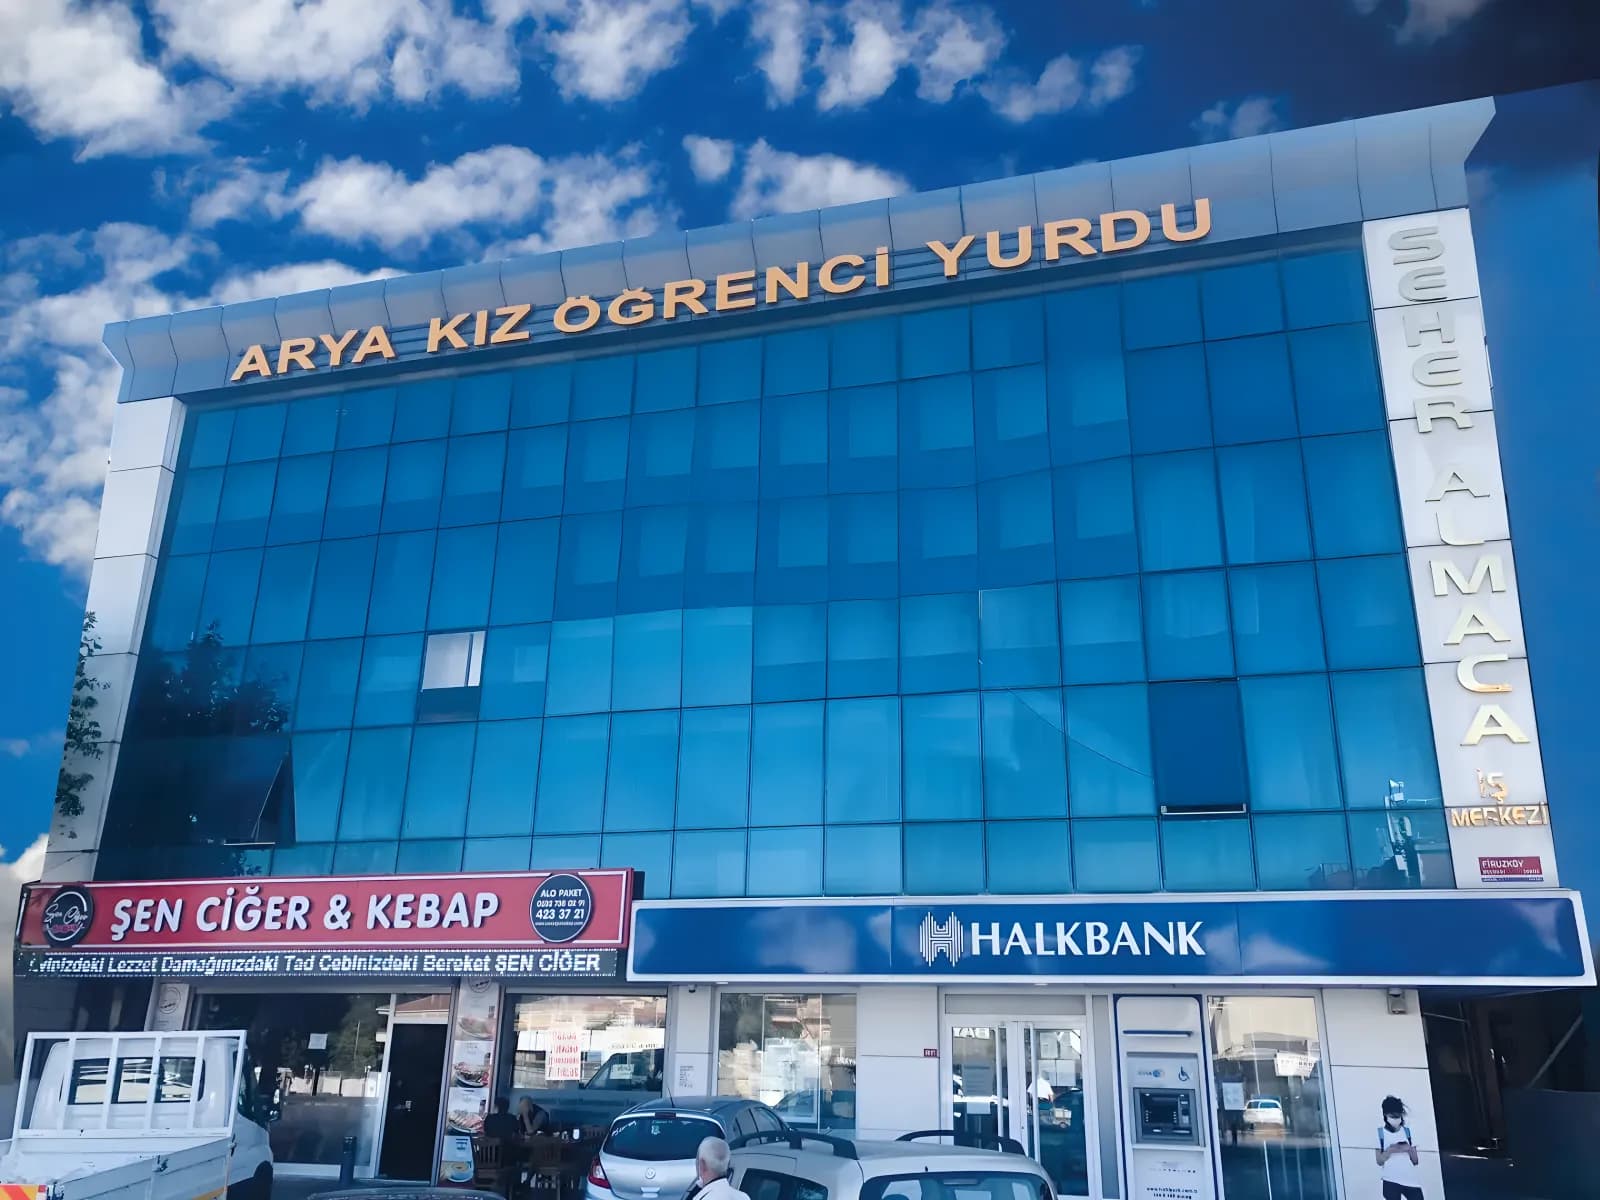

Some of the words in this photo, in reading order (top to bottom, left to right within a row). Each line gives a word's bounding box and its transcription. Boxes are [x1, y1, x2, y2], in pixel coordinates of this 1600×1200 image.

[231, 325, 399, 382] ARYA
[427, 303, 534, 354] KIZ
[552, 246, 891, 334] ÖĞRENCİ
[926, 197, 1213, 278] YURDU
[1387, 226, 1474, 435] SEHER
[1425, 470, 1531, 746] ALMACA
[1476, 767, 1510, 804] İŞ
[1451, 800, 1549, 827] MERKEZİ
[540, 889, 557, 898] ALO
[558, 888, 583, 897] PAKET
[109, 898, 184, 942] ŞEN
[196, 885, 309, 935] CİĞER
[322, 898, 352, 931] &
[366, 892, 501, 930] KEBAP
[535, 908, 556, 920] 423
[558, 908, 571, 920] 37
[573, 908, 585, 919] 21
[970, 921, 1206, 957] HALKBANK
[107, 957, 157, 972] Lezzet
[161, 955, 279, 975] Damağınızdaki
[284, 955, 314, 971] Tad
[423, 955, 491, 972] Bereket
[494, 955, 535, 975] ŞEN
[539, 951, 600, 972] CİĞER
